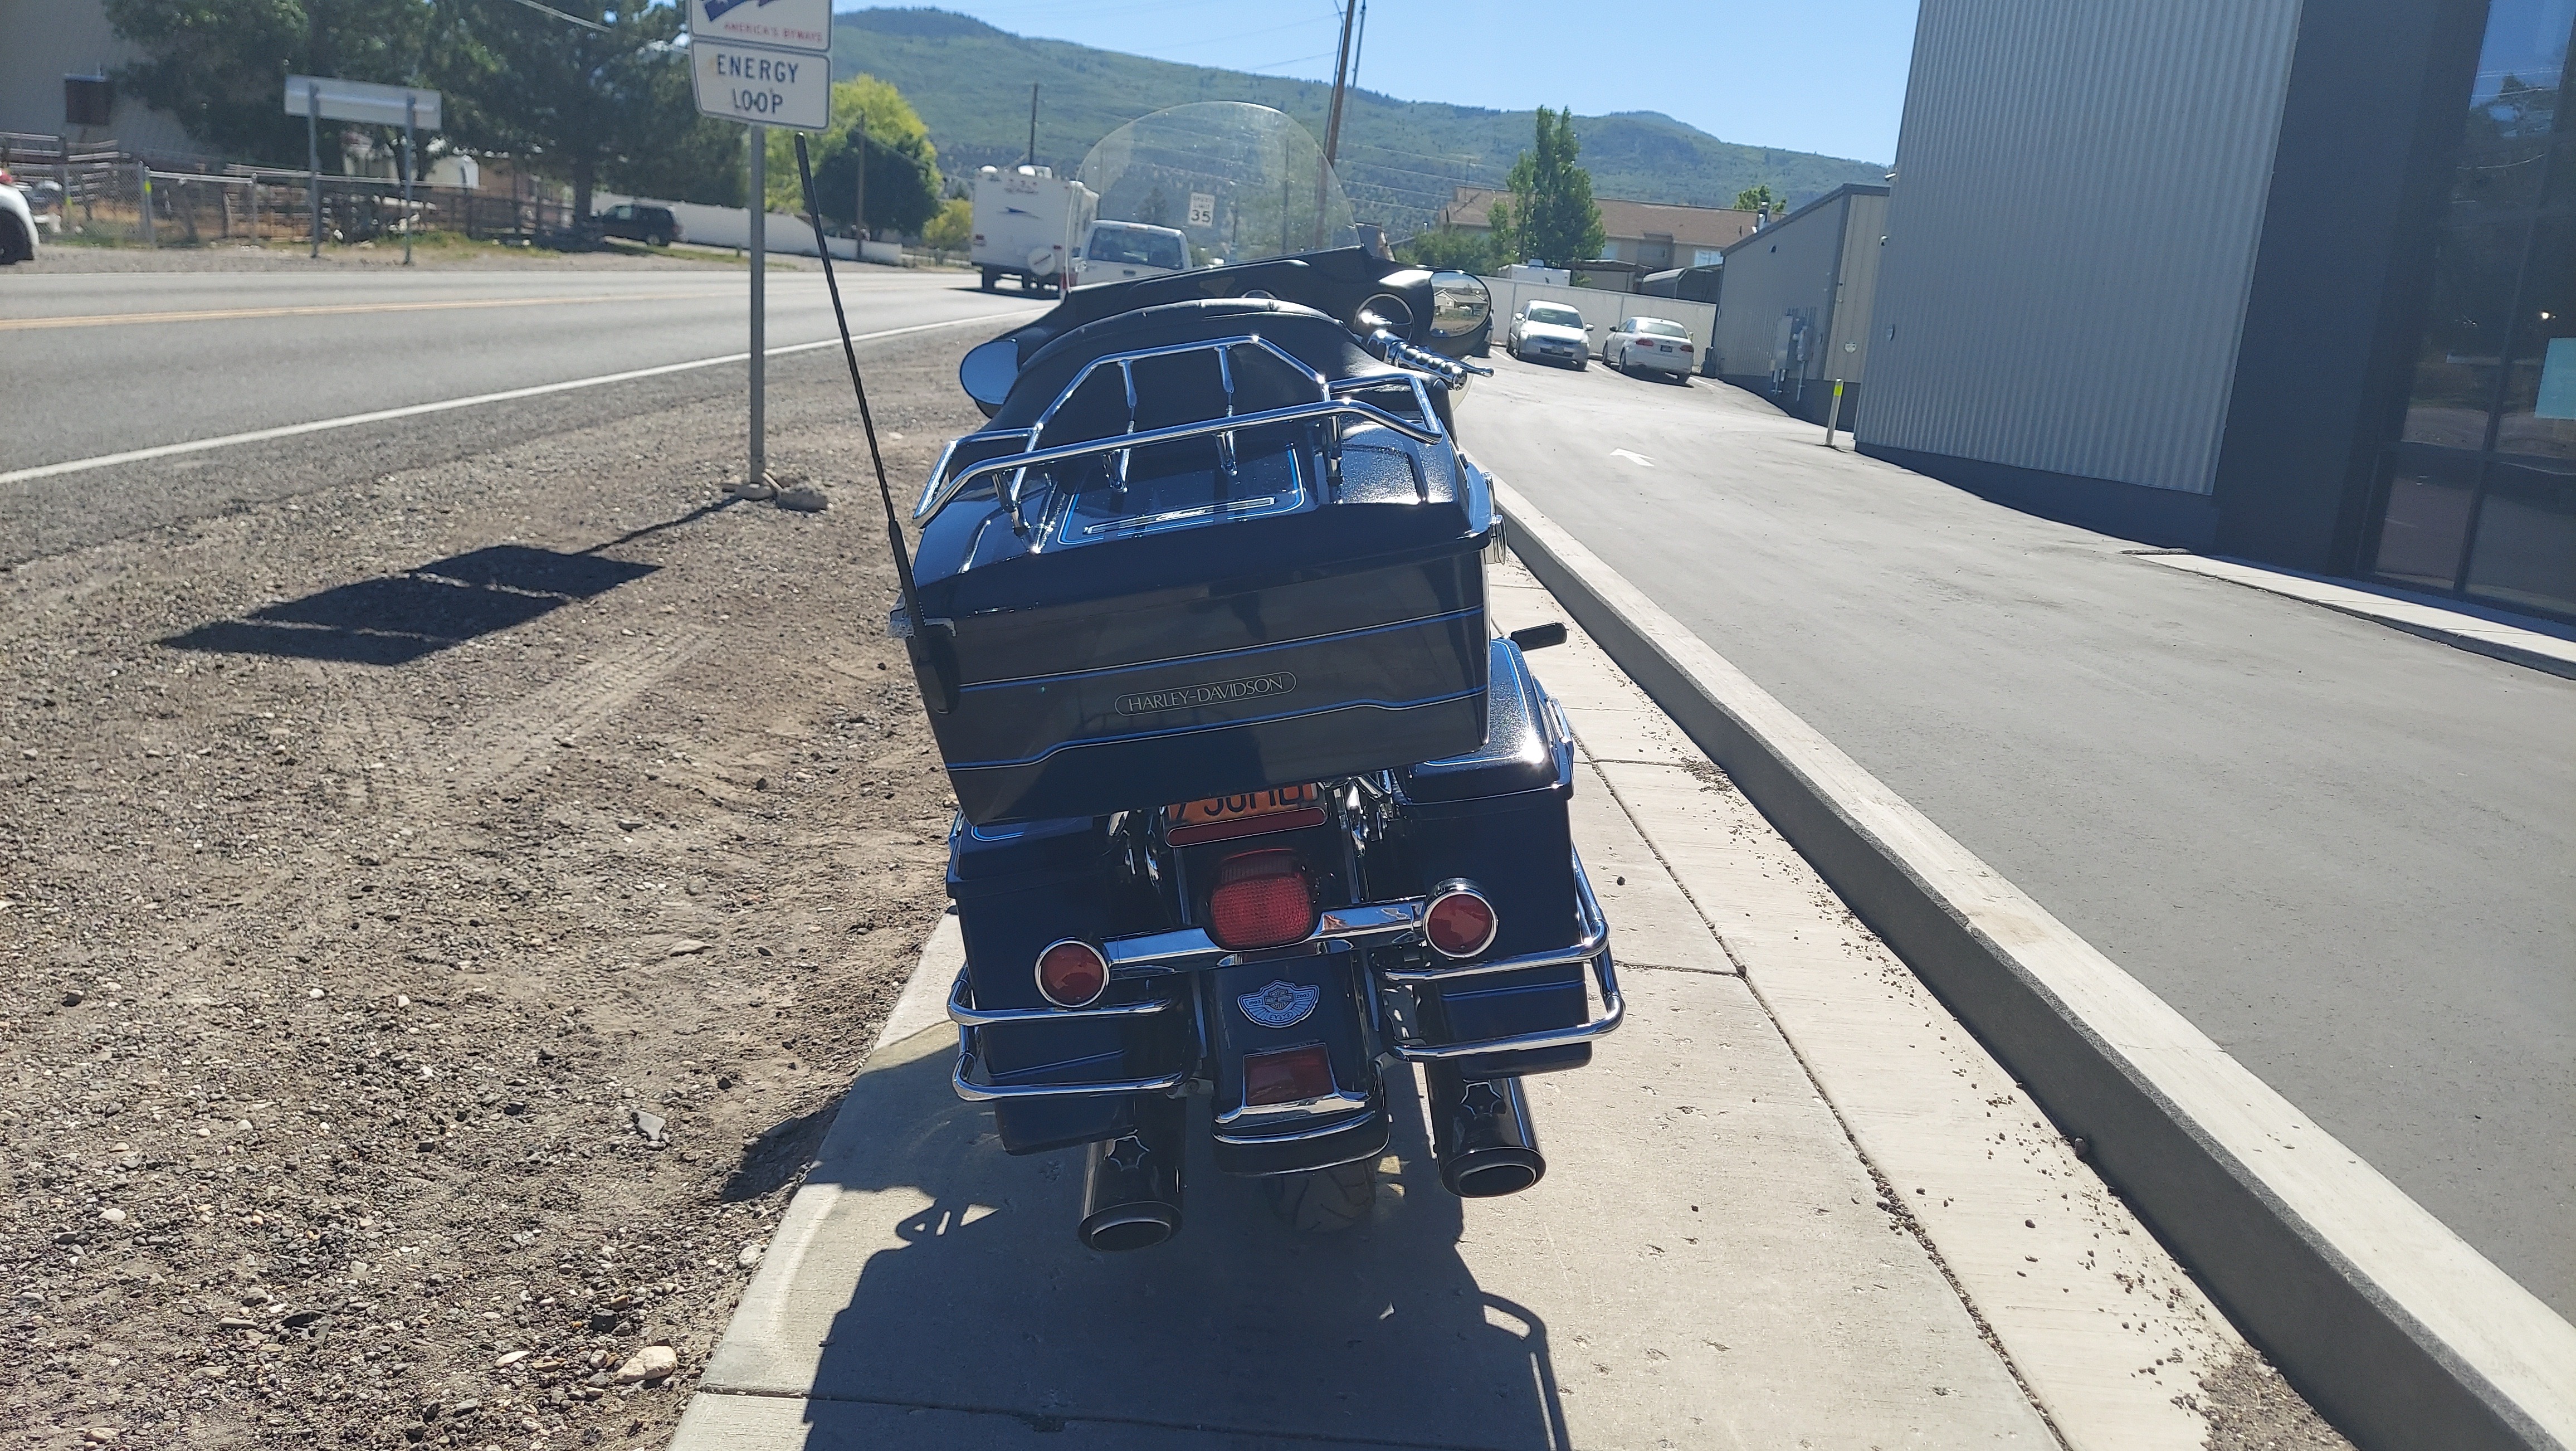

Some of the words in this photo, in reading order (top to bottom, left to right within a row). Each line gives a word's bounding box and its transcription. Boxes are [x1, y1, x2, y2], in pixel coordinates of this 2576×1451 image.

[716, 53, 799, 83] ENERGY
[733, 88, 783, 114] LOOP
[1191, 210, 1211, 223] 35
[1128, 676, 1284, 712] HARLEY-DAVIDSON
